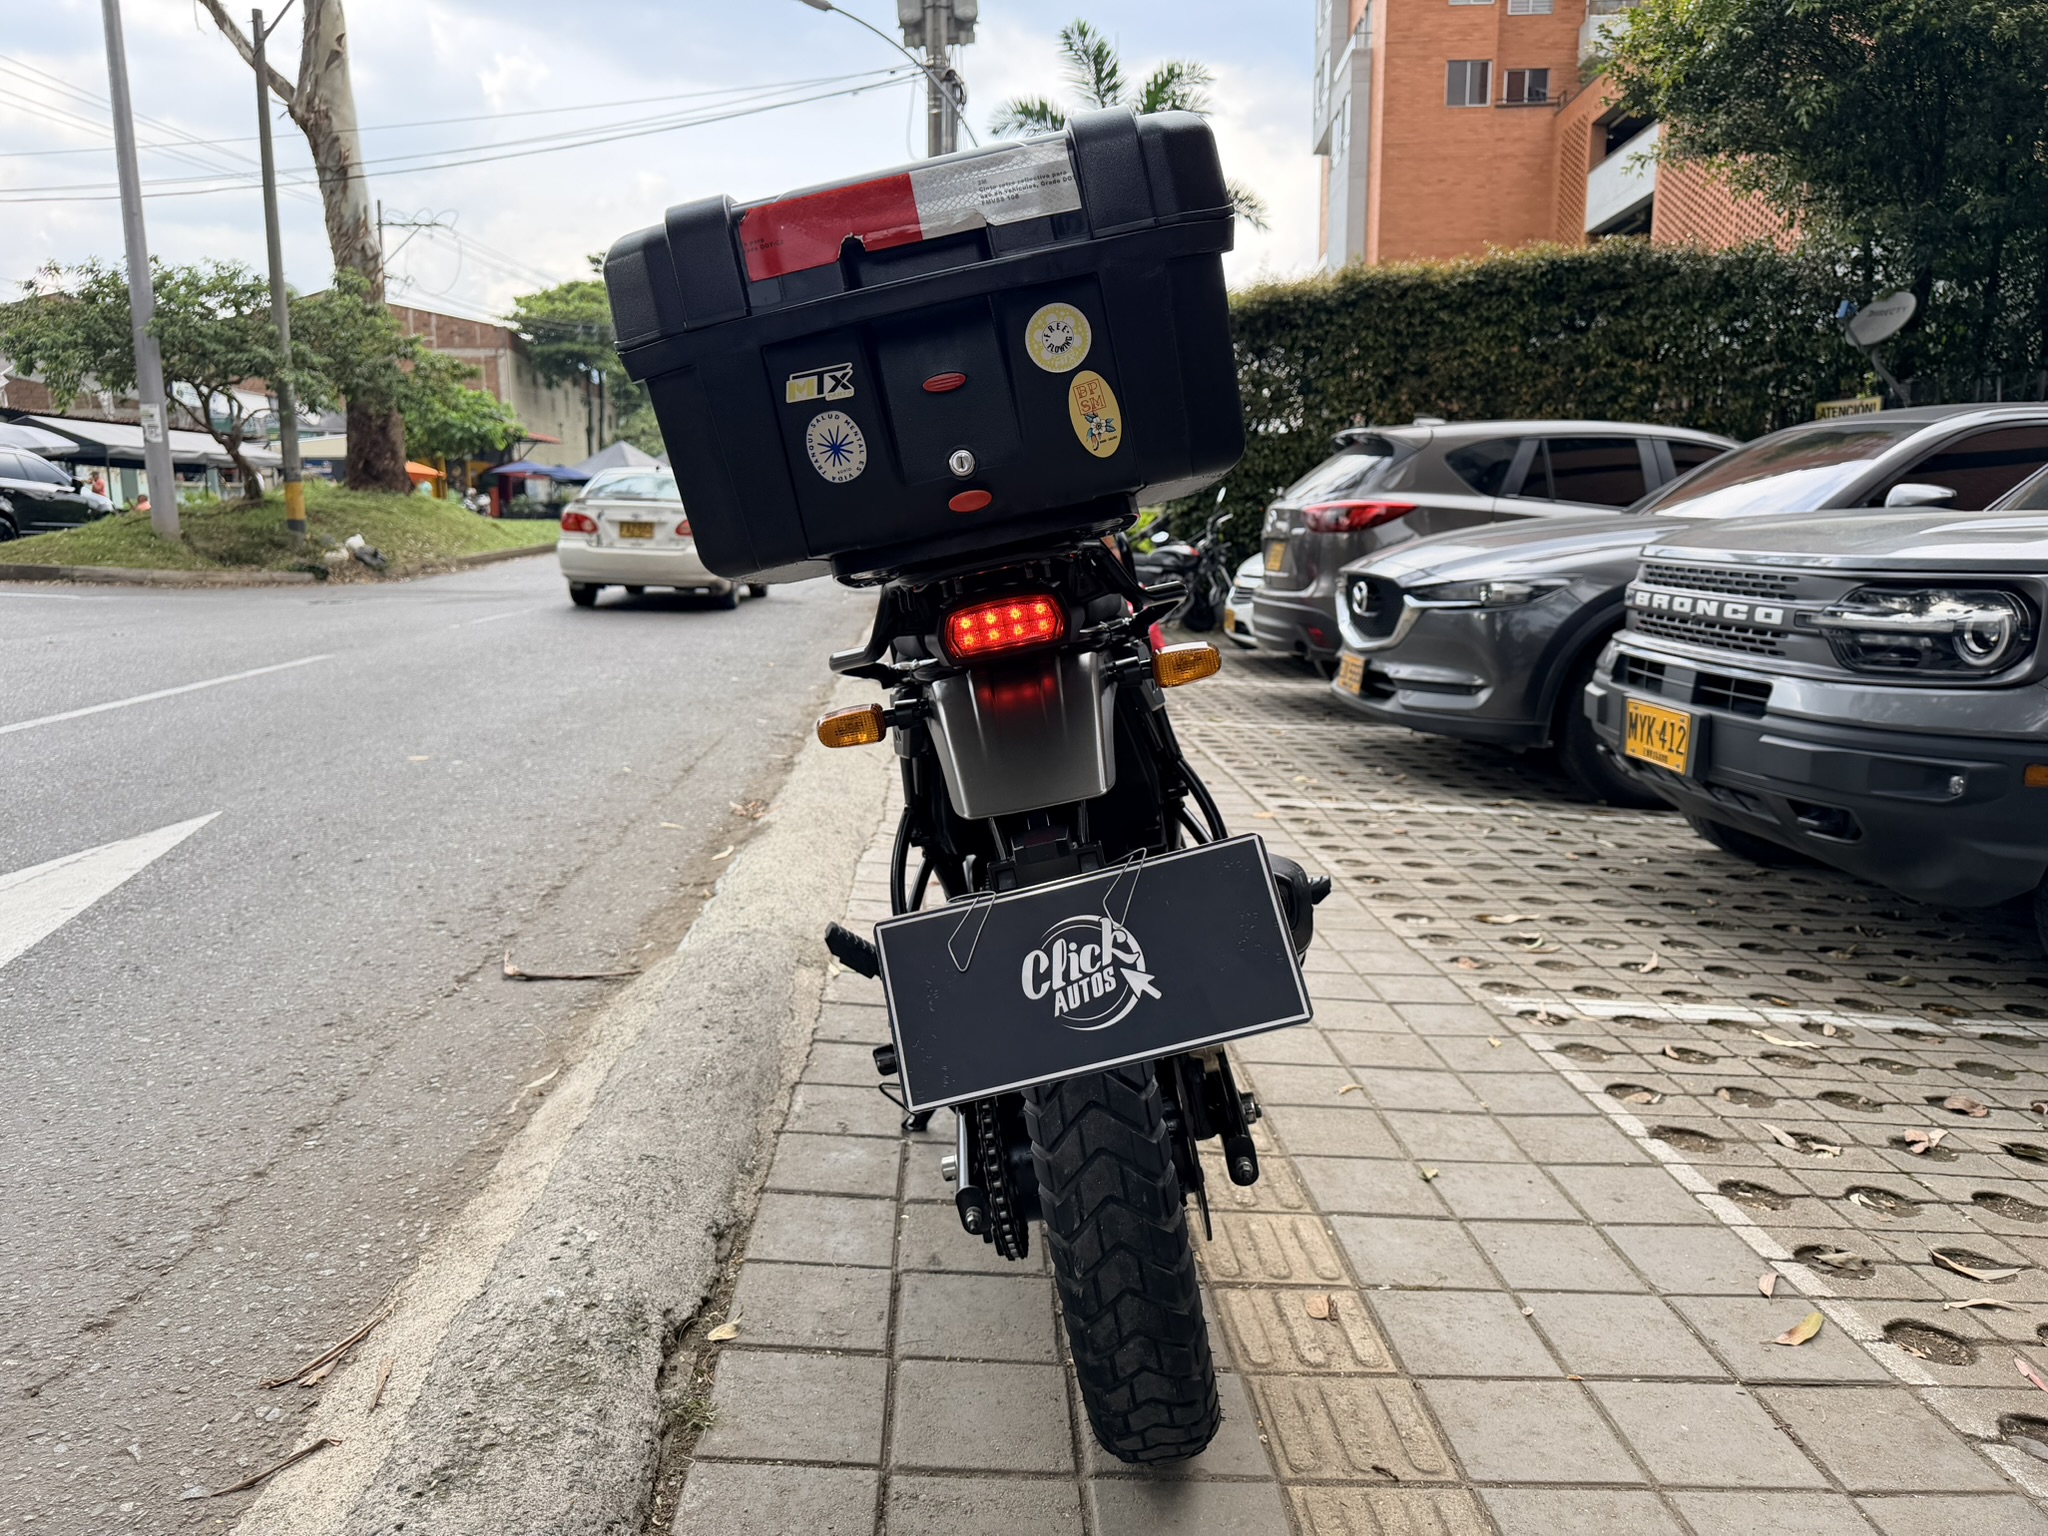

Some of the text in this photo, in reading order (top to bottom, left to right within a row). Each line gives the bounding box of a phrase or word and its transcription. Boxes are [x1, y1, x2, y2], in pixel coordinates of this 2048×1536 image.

[1040, 179, 1060, 187] Grado
[1051, 170, 1067, 179] para
[1043, 322, 1068, 338] FREE
[1046, 336, 1073, 353] FLOWING
[788, 365, 852, 401] MTX
[1076, 381, 1098, 399] BP
[810, 413, 840, 429] SALUD
[844, 419, 865, 455] MENTAL
[856, 460, 865, 472] ES
[831, 473, 854, 482] VIDA
[1634, 590, 1785, 626] BRONCO
[1021, 917, 1140, 1000] Click
[1054, 965, 1117, 1018] AUTOS
